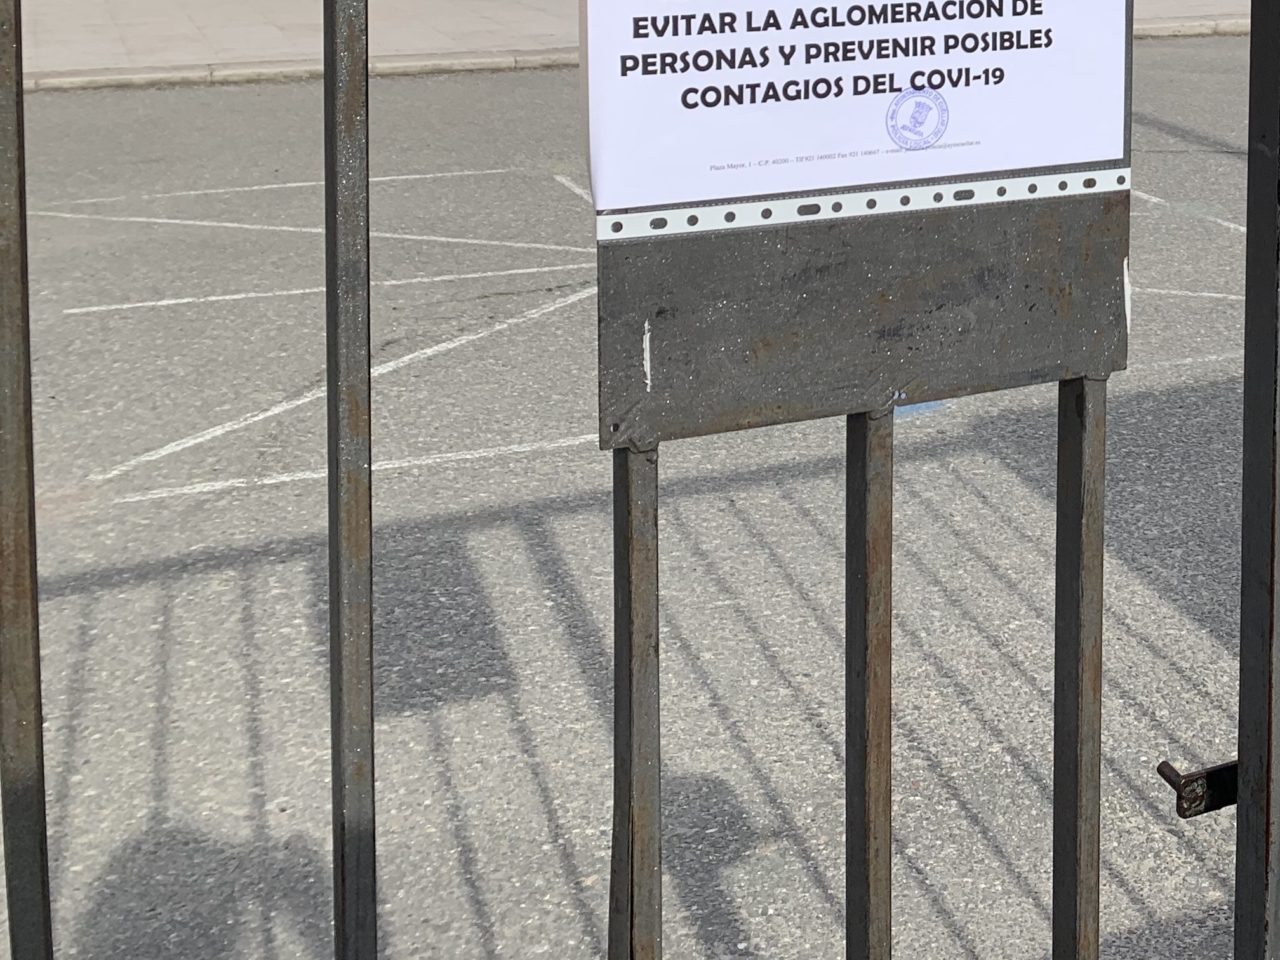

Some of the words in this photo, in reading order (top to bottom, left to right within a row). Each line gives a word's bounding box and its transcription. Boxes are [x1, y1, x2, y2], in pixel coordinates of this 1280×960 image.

[633, 13, 736, 38] EVITAR
[747, 10, 781, 31] LA
[621, 46, 769, 76] PERSONAS
[779, 45, 796, 65] Y
[806, 36, 935, 64] PREVENIR
[944, 29, 1053, 54] POSIBLES
[681, 77, 843, 109] CONTAGIOS
[853, 74, 902, 95] DEL
[910, 68, 1004, 91] COVI-19
